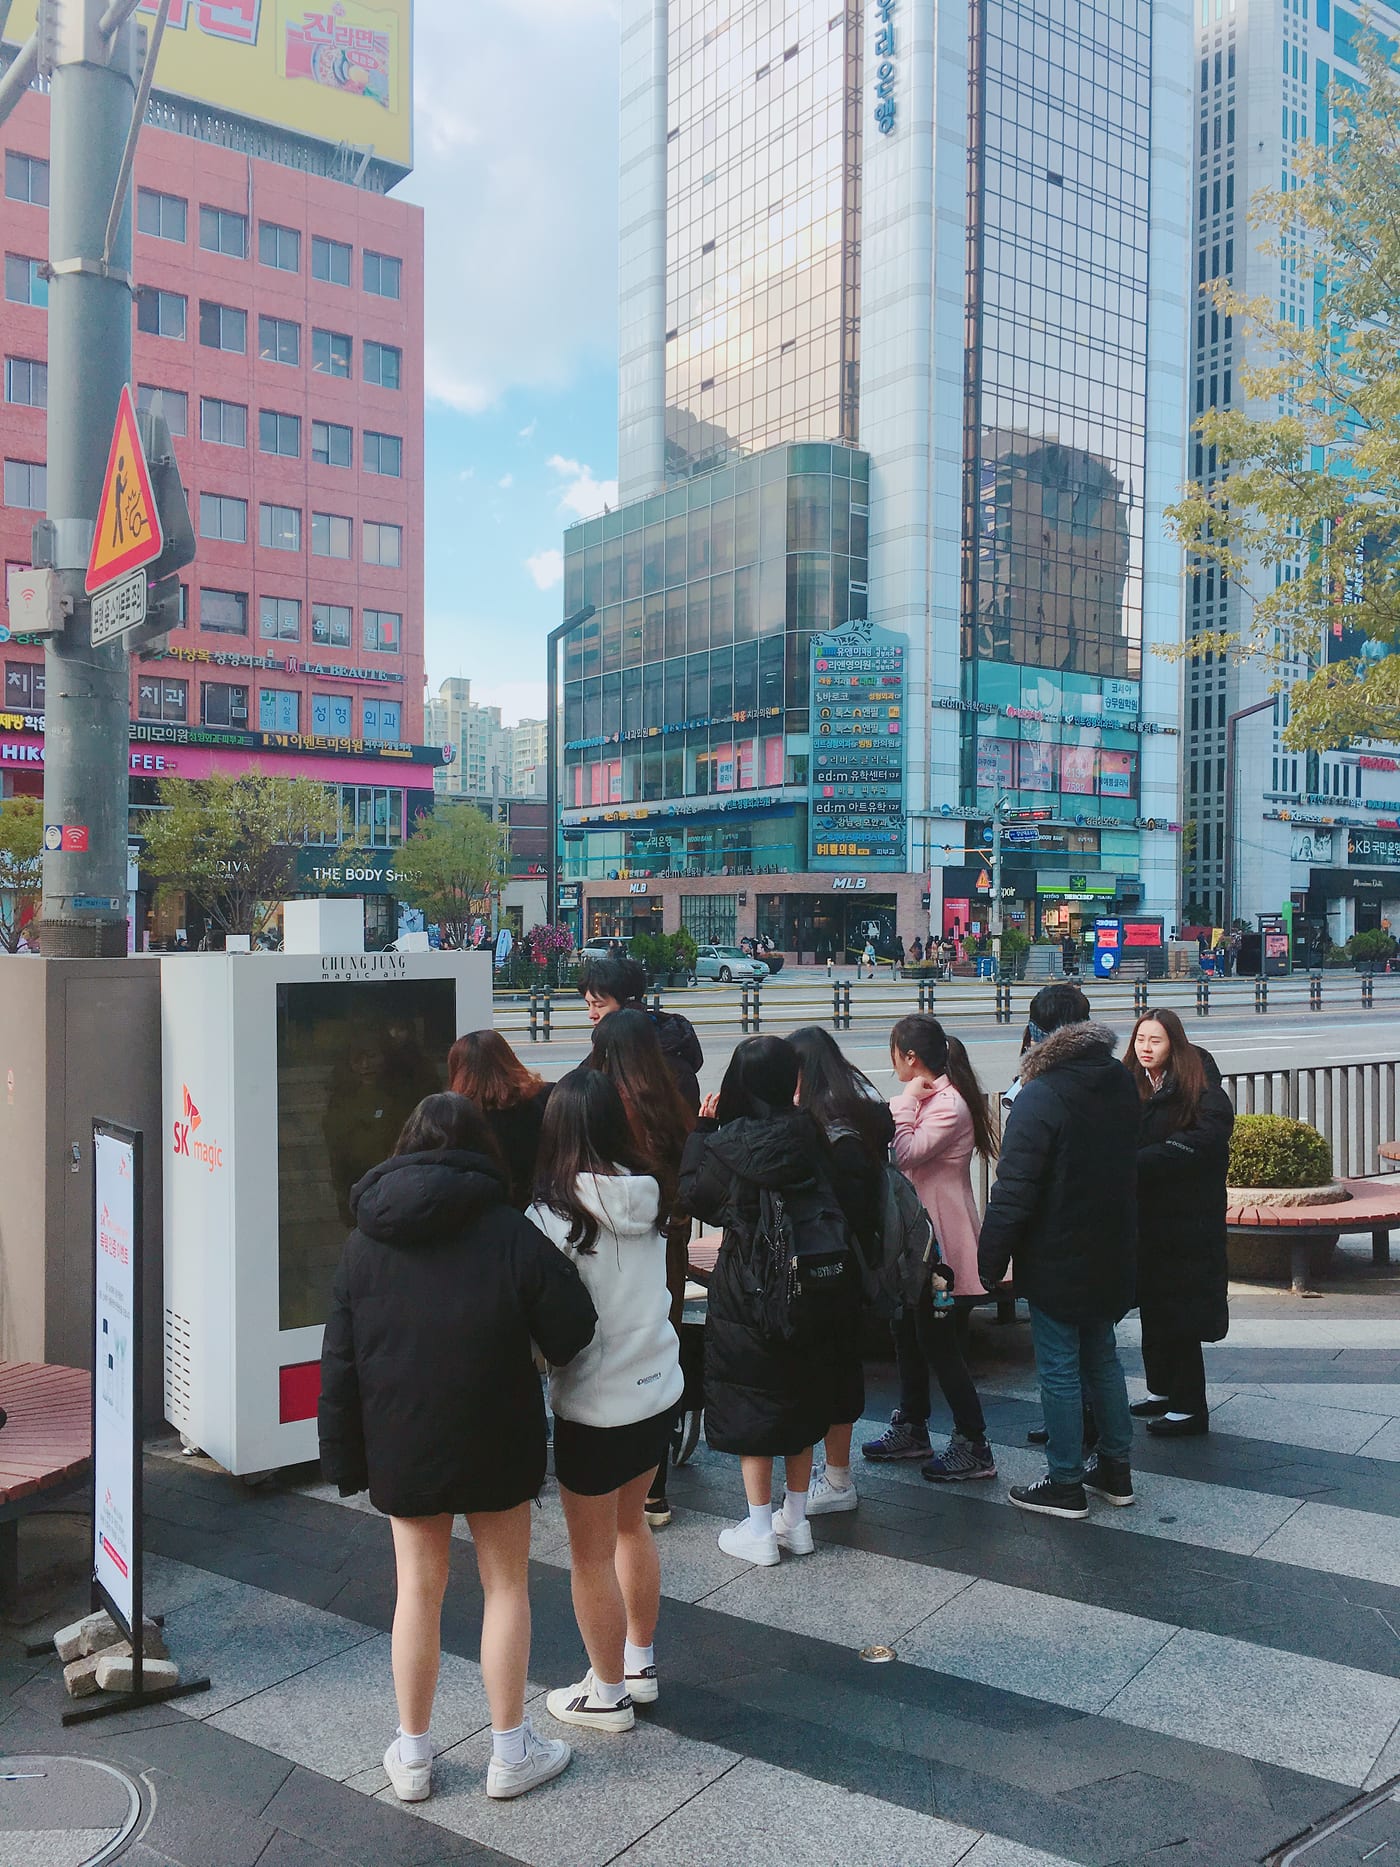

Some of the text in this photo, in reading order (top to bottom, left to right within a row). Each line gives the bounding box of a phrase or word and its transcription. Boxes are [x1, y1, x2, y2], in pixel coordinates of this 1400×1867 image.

[302, 11, 375, 50] 진라면
[304, 661, 388, 681] LA BEAUTE
[140, 685, 185, 707] 치과
[131, 754, 165, 770] FEE
[818, 770, 848, 782] ed:m
[816, 801, 846, 813] ed:m
[1355, 840, 1371, 854] KB
[215, 860, 250, 873] DIVA
[312, 867, 341, 881] THE
[345, 868, 382, 882] BODY
[629, 882, 647, 893] MLB
[832, 877, 867, 889] MLB
[1000, 886, 1016, 899] spoir
[322, 955, 406, 971] CHUNG JUNG
[322, 969, 406, 981] magic air
[173, 1121, 189, 1157] SK
[193, 1139, 223, 1172] magic
